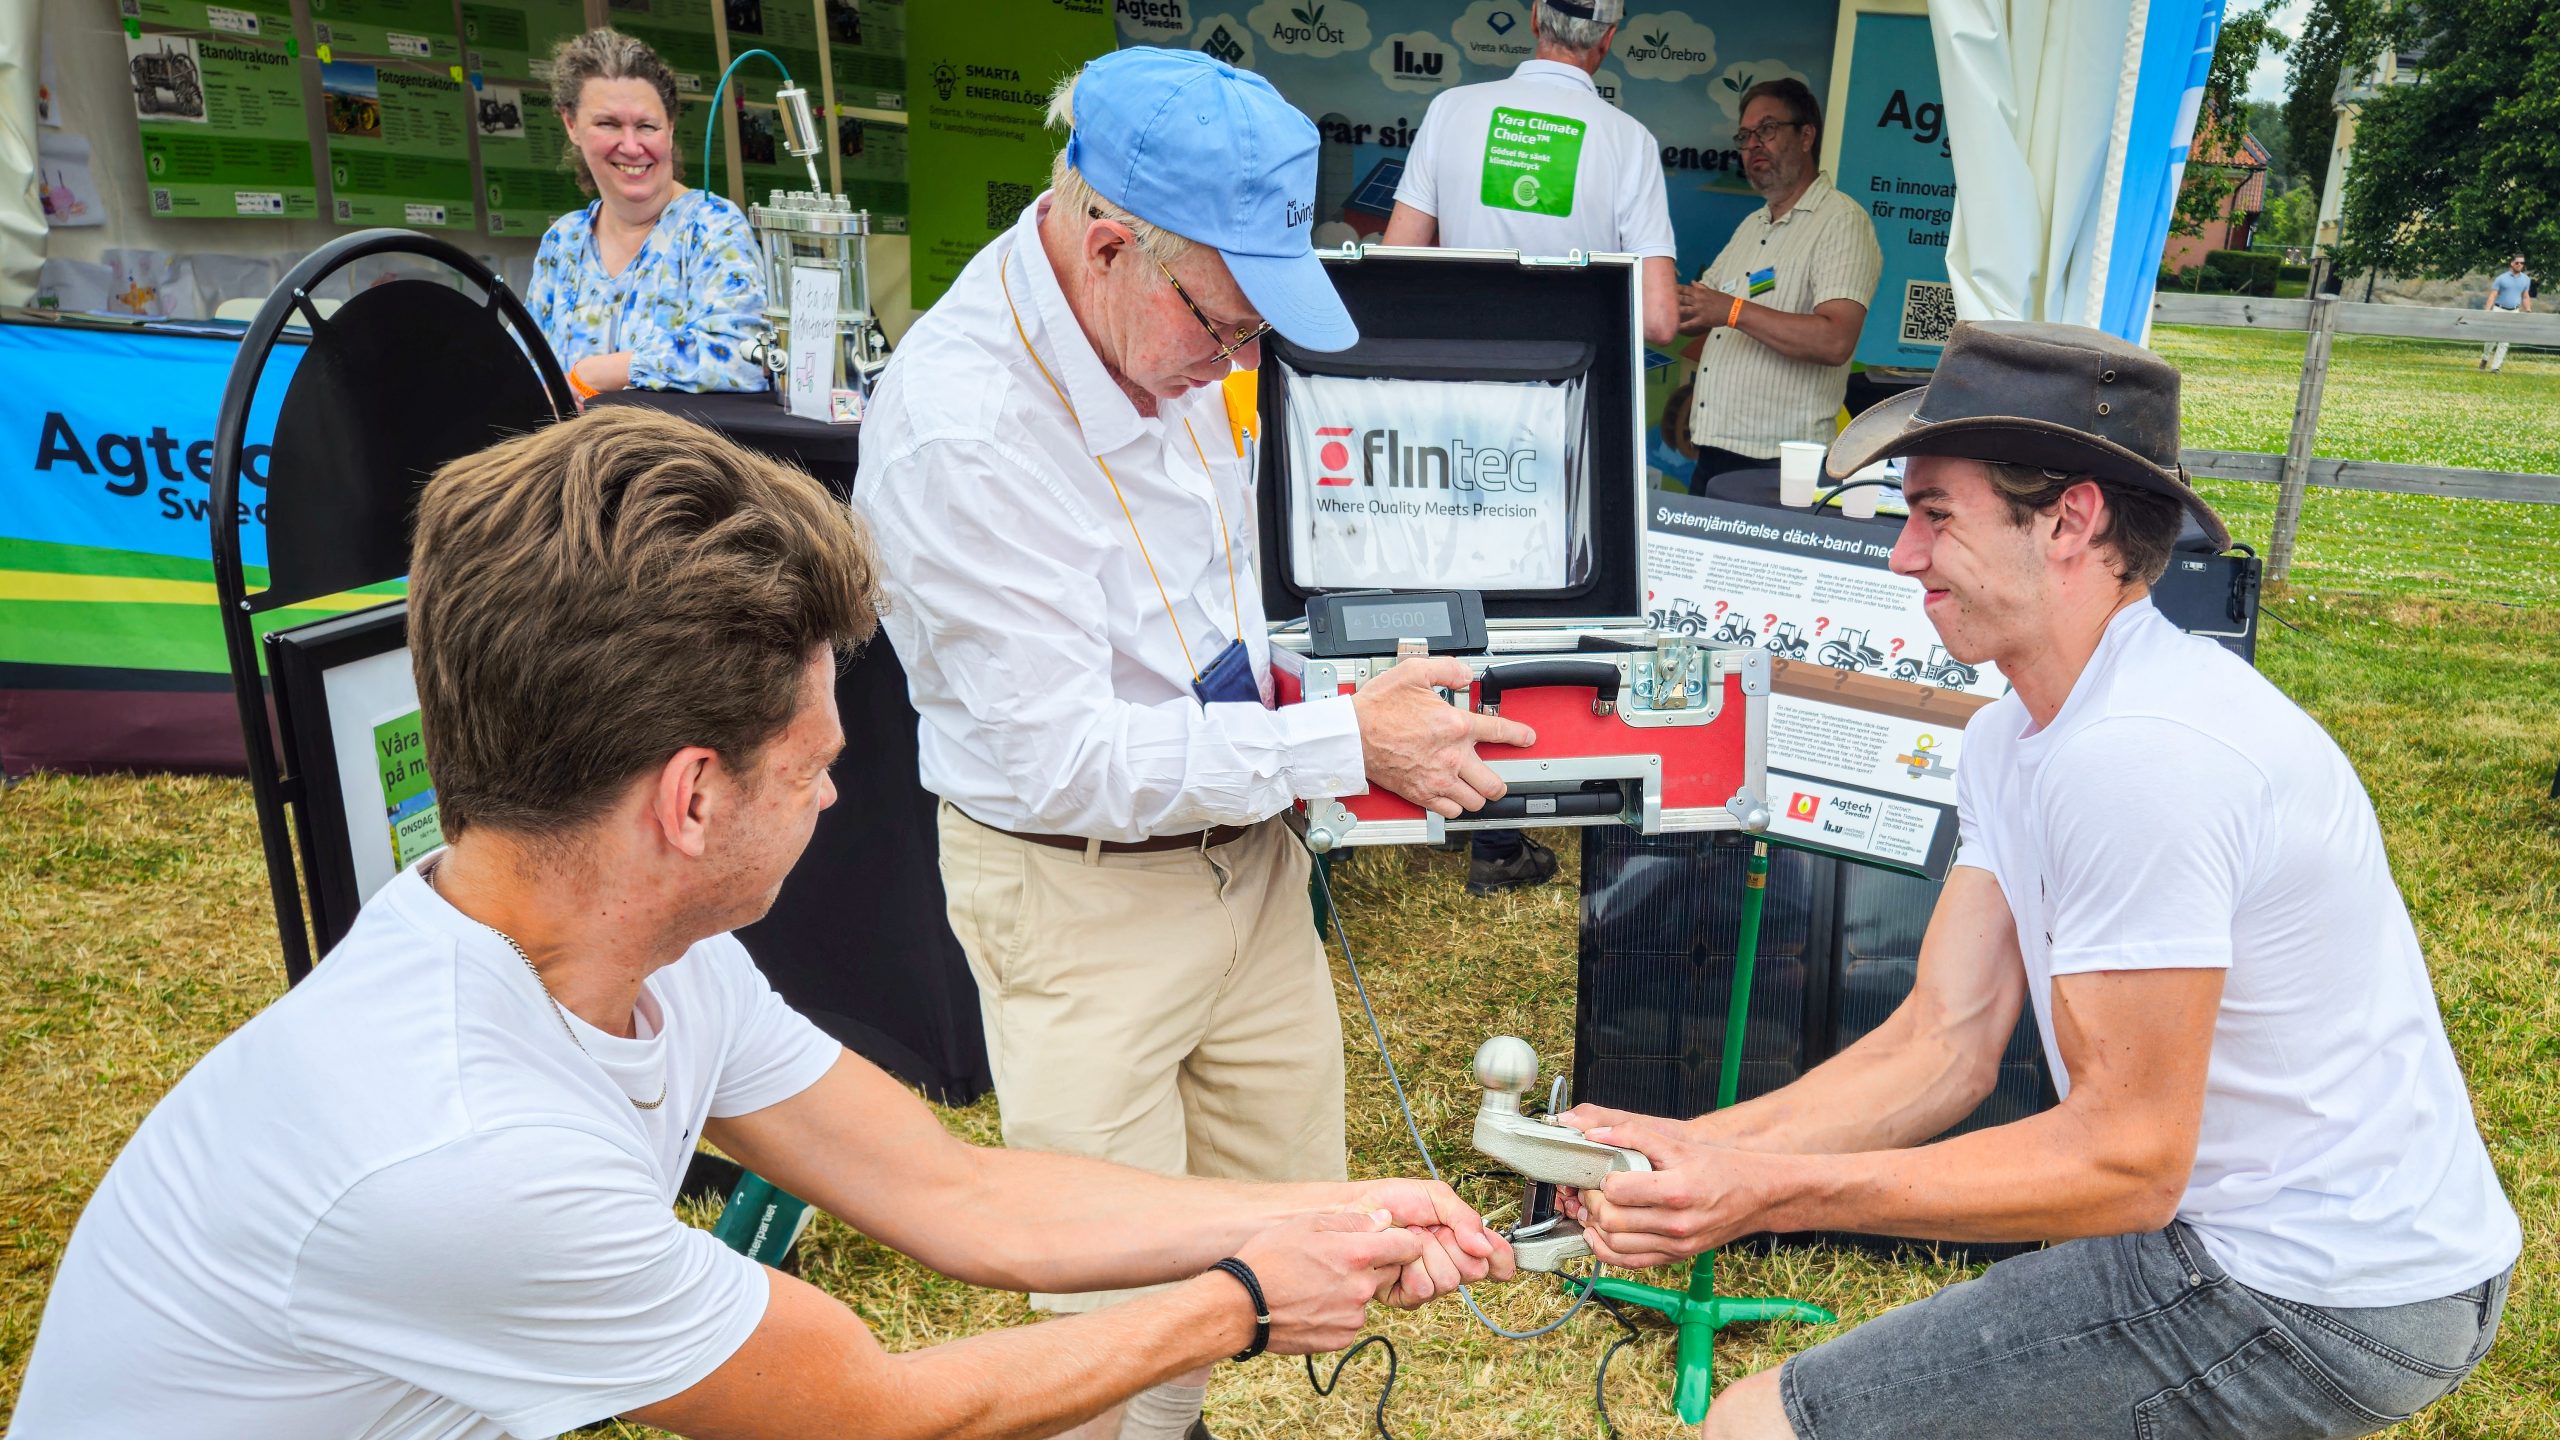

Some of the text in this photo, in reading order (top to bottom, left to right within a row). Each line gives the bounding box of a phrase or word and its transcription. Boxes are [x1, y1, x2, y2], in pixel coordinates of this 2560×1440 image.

[1064, 3, 1103, 15] Sweden
[1116, 0, 1182, 20] Agtech
[1142, 16, 1183, 30] Sweden
[1273, 22, 1344, 44] Agro Öst
[199, 43, 289, 66] Etanoltraktorn
[1470, 41, 1532, 55] Vreta Kluster
[1627, 44, 1706, 63] Agro Örebro
[377, 69, 461, 92] Fotogentraktorn
[965, 64, 1021, 82] SMARTA
[1498, 113, 1579, 136] Yara Climate
[1877, 90, 1945, 144] Ag
[1319, 120, 1372, 145] rar
[1489, 156, 1540, 170] klimatavtryck
[1490, 146, 1551, 162] Gödsel för sänkt
[1870, 176, 1956, 197] En innovat
[1872, 200, 1951, 226] för morgo
[1908, 227, 1949, 247] lantb
[35, 411, 271, 497] Agtec
[1363, 428, 1537, 493] flintec
[1316, 498, 1537, 518] Where Quality Meets Precision
[1656, 506, 1780, 541] Systemjämförelse
[1783, 525, 1861, 554] däck-band
[1370, 611, 1426, 629] 19600
[382, 728, 420, 756] Våra
[385, 760, 414, 793] på
[1830, 796, 1872, 815] Agtech
[1844, 807, 1871, 819] Sweden
[401, 814, 433, 837] ONSDAG
[747, 1203, 778, 1261] nterpartiet
